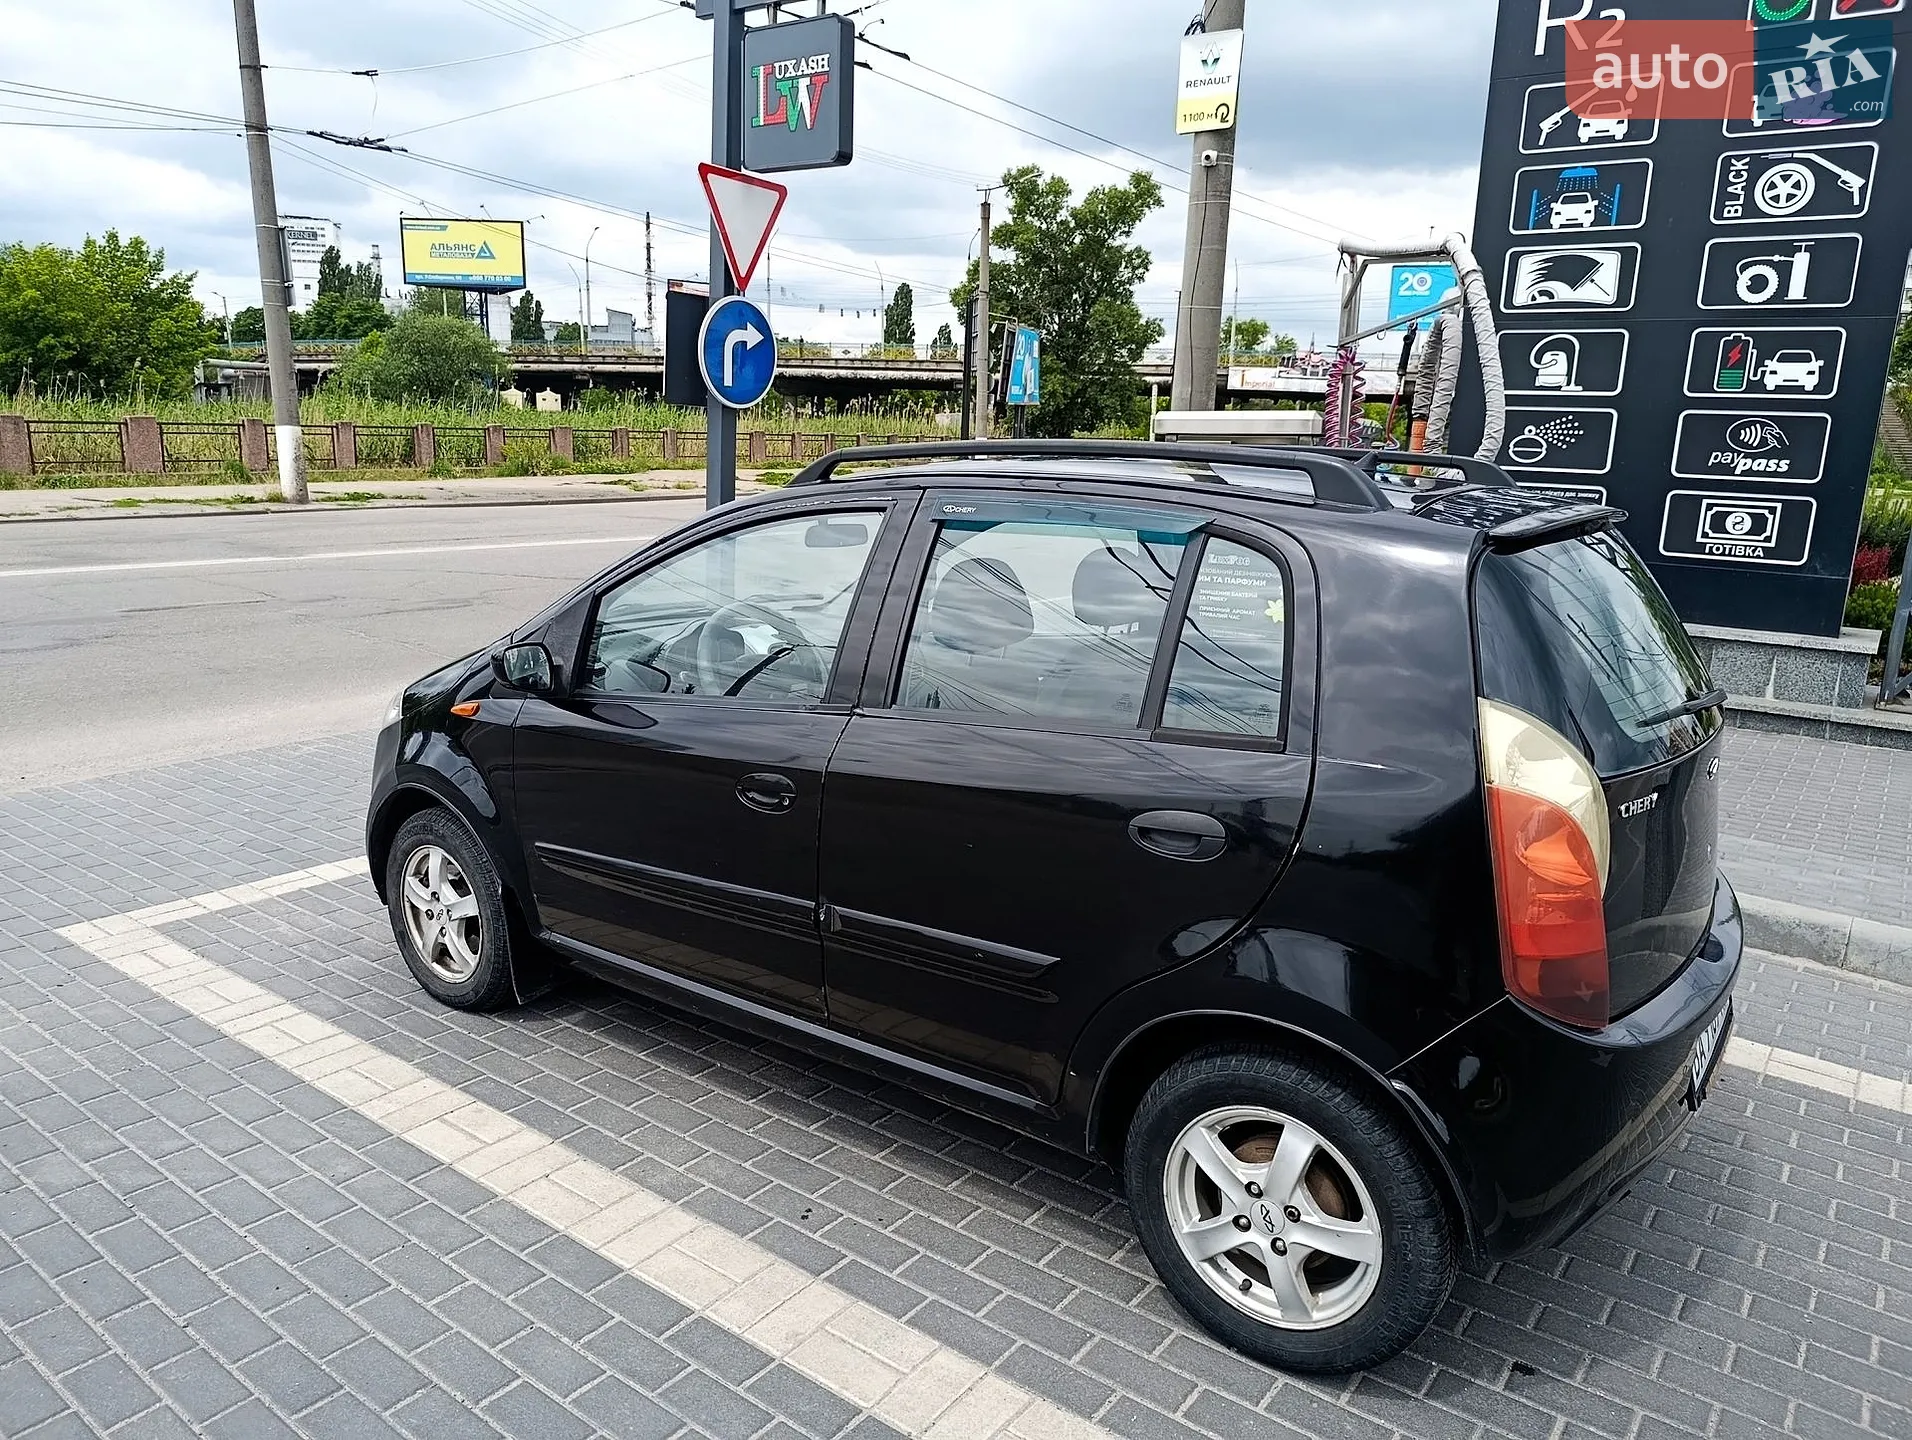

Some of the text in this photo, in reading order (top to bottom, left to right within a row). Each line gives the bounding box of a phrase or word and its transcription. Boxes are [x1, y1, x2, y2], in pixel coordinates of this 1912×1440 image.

[1185, 75, 1232, 88] RENAULT
[1183, 111, 1205, 122] 1100
[1722, 156, 1751, 217] BLACK
[288, 231, 314, 240] KERNEL
[430, 243, 476, 252] АЛЬЯНС
[1398, 271, 1433, 296] 20
[1241, 369, 1276, 388] Imperial
[1704, 543, 1764, 557] ГОТІВКА
[1212, 576, 1223, 584] ТА
[1225, 577, 1266, 586] ПАРФУМИ
[1618, 792, 1658, 818] CHERY
